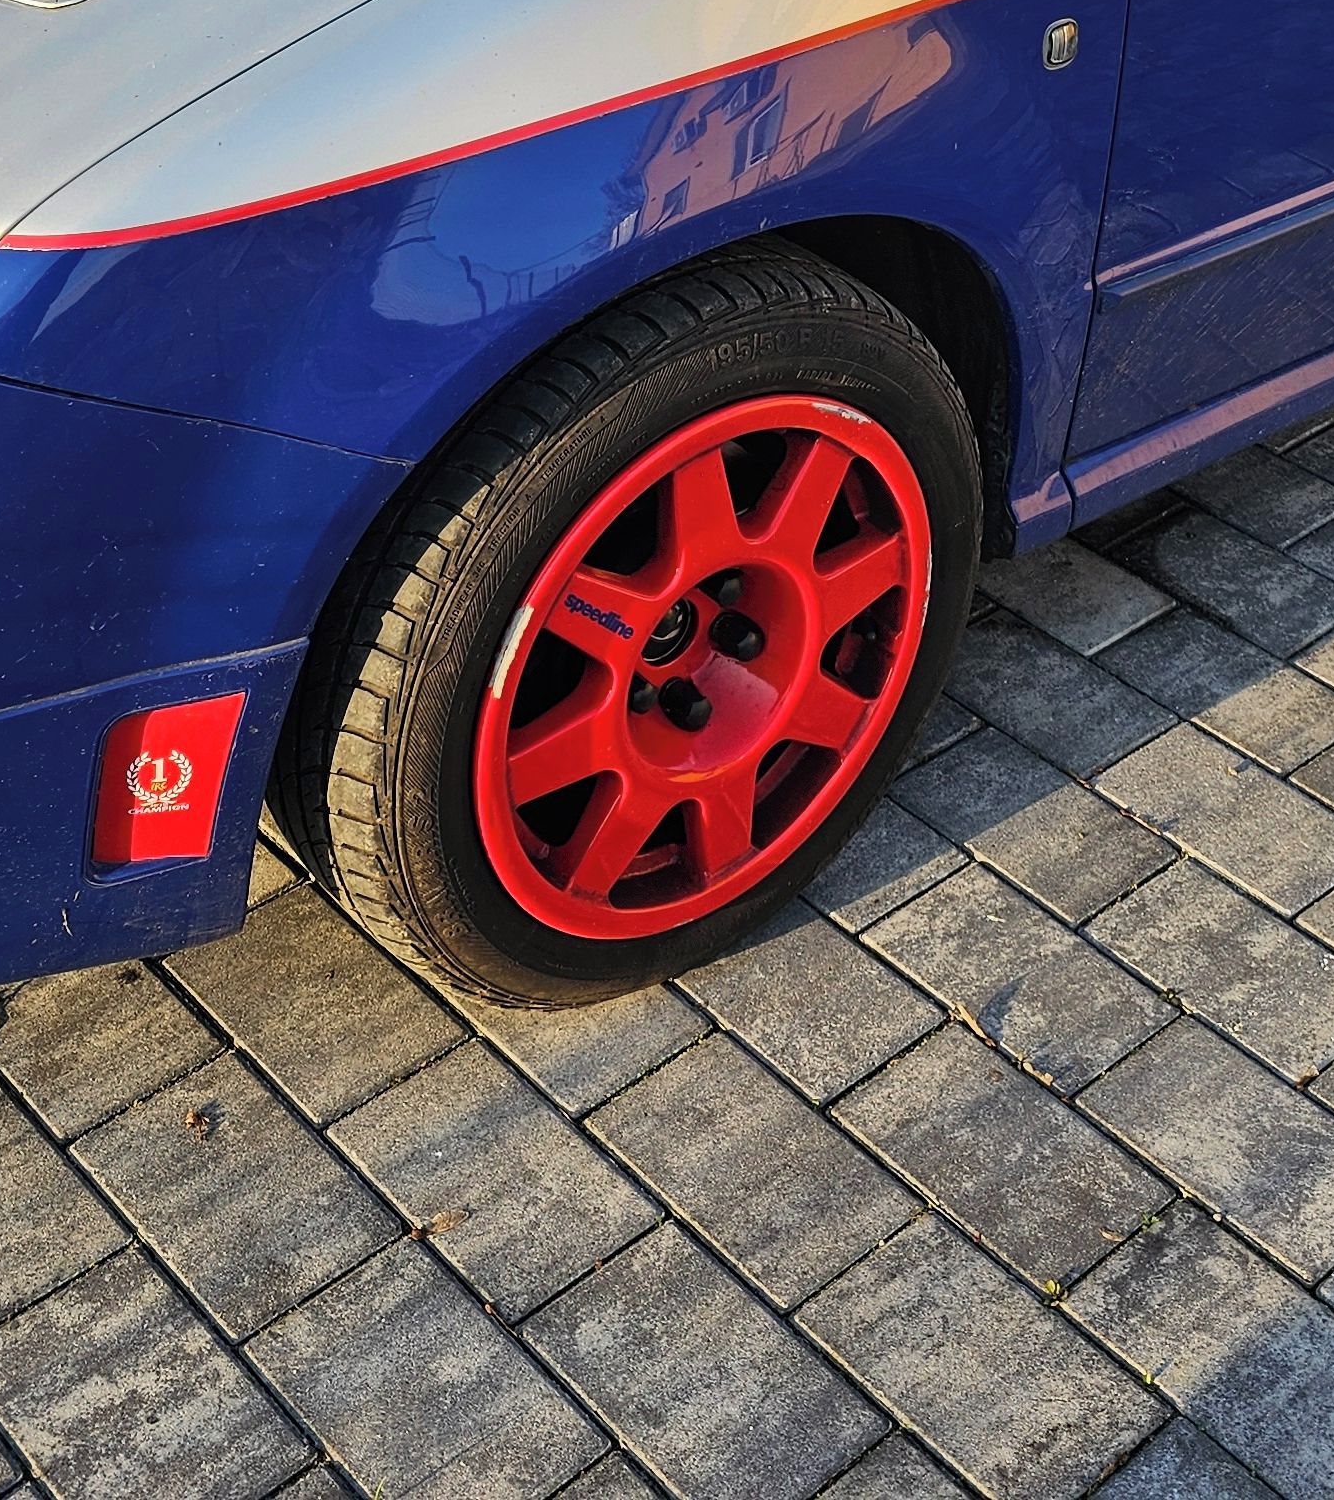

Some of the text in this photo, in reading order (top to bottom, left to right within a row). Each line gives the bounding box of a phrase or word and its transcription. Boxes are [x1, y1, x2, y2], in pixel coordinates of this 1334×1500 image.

[488, 506, 522, 552] TRACTION
[539, 426, 595, 482] TEMPERATURE
[564, 593, 634, 639] speedline
[151, 757, 167, 782] 1
[128, 803, 189, 815] CHAMPION
